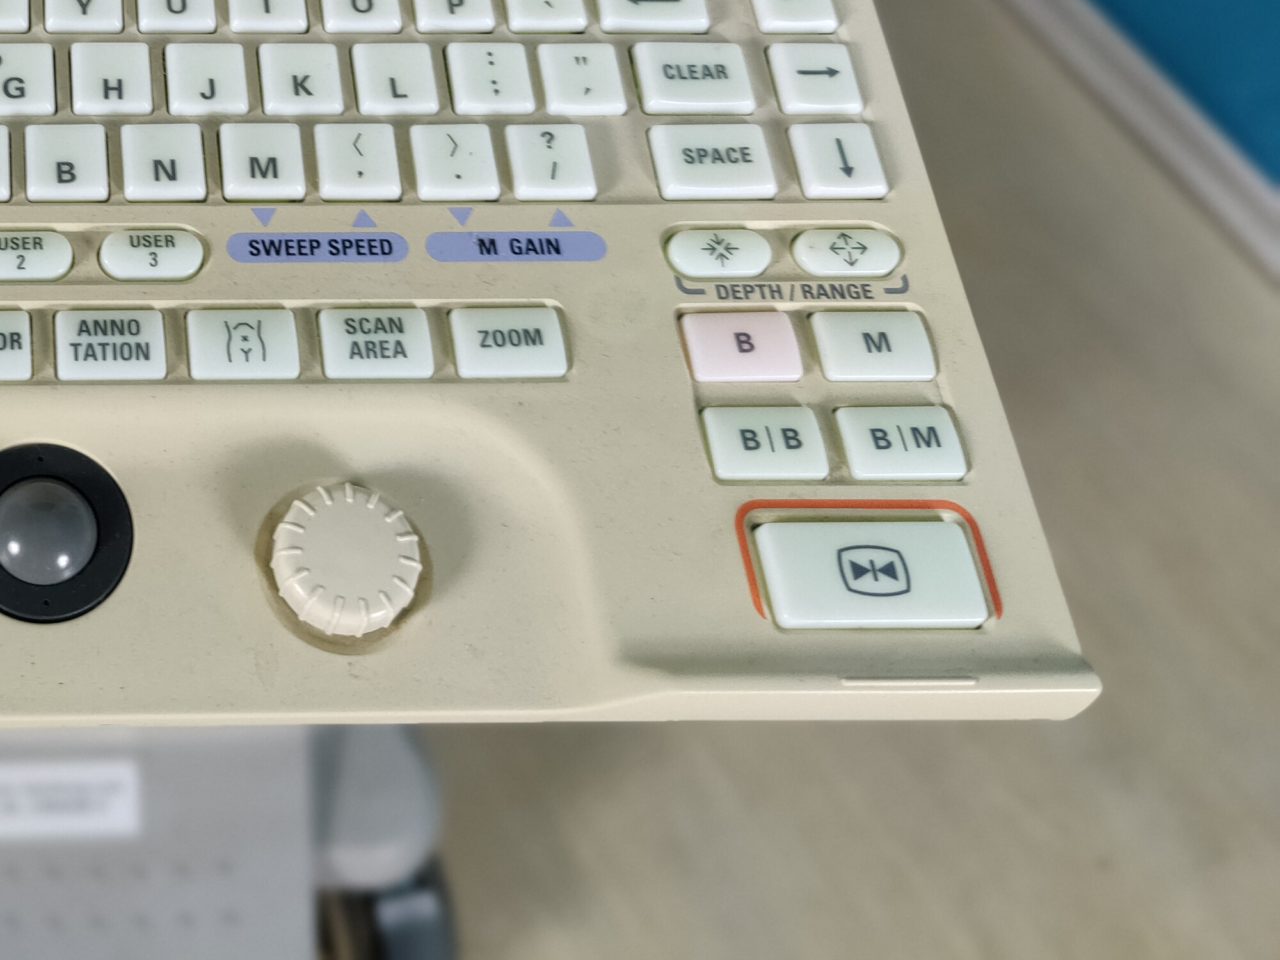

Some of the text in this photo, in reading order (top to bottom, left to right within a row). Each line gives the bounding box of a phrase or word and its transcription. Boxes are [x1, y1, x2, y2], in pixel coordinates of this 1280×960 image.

[662, 63, 729, 81] CLEAR
[2, 76, 26, 100] G
[102, 78, 124, 100] H
[199, 78, 216, 101] J
[291, 74, 314, 97] K
[389, 77, 409, 99] L
[540, 130, 555, 150] ?
[681, 146, 753, 165] SPACE
[55, 161, 77, 184] B
[152, 158, 178, 182] N
[249, 156, 279, 179] M
[128, 234, 176, 249] USER
[248, 238, 393, 257] SWEEP SPEED
[477, 237, 562, 256] M GAIN
[16, 254, 26, 270] 2
[148, 251, 159, 268] 3
[714, 283, 785, 301] DEPTH
[801, 283, 875, 301] RANGE
[77, 318, 141, 337] ANNO
[343, 316, 405, 335] SCAN
[477, 327, 544, 349] ZOOM
[733, 331, 755, 354] B
[861, 331, 892, 354] M
[69, 341, 151, 362] TATION
[349, 339, 408, 360] AREA
